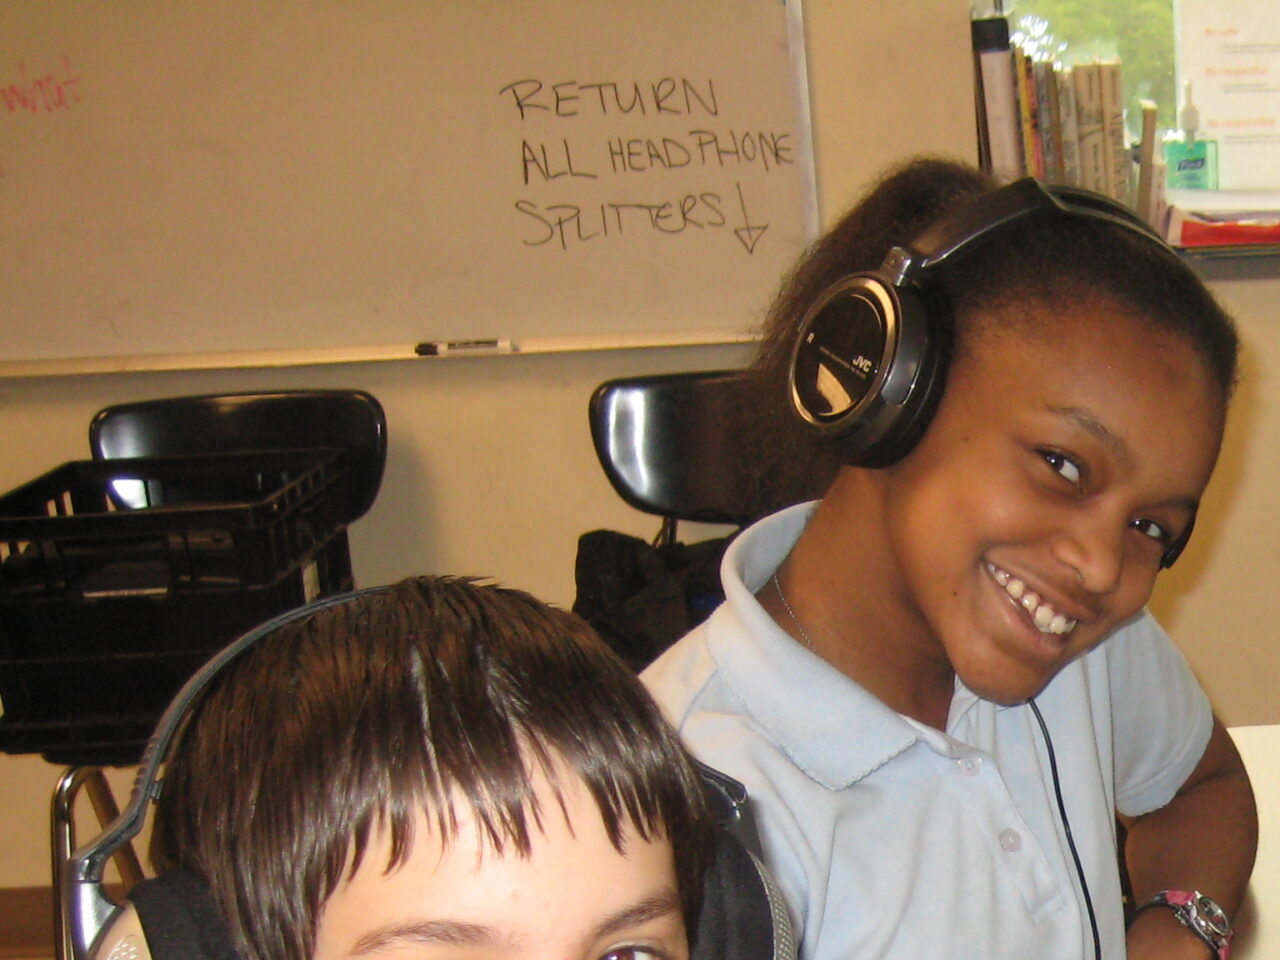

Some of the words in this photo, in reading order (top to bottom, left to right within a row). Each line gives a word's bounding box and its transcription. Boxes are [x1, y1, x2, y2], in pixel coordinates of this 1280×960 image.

[500, 77, 719, 120] RETURN
[522, 138, 598, 184] ALL
[608, 129, 794, 174] HEADPHONE
[515, 193, 726, 250] SPLITTERS
[852, 355, 872, 372] JVC
